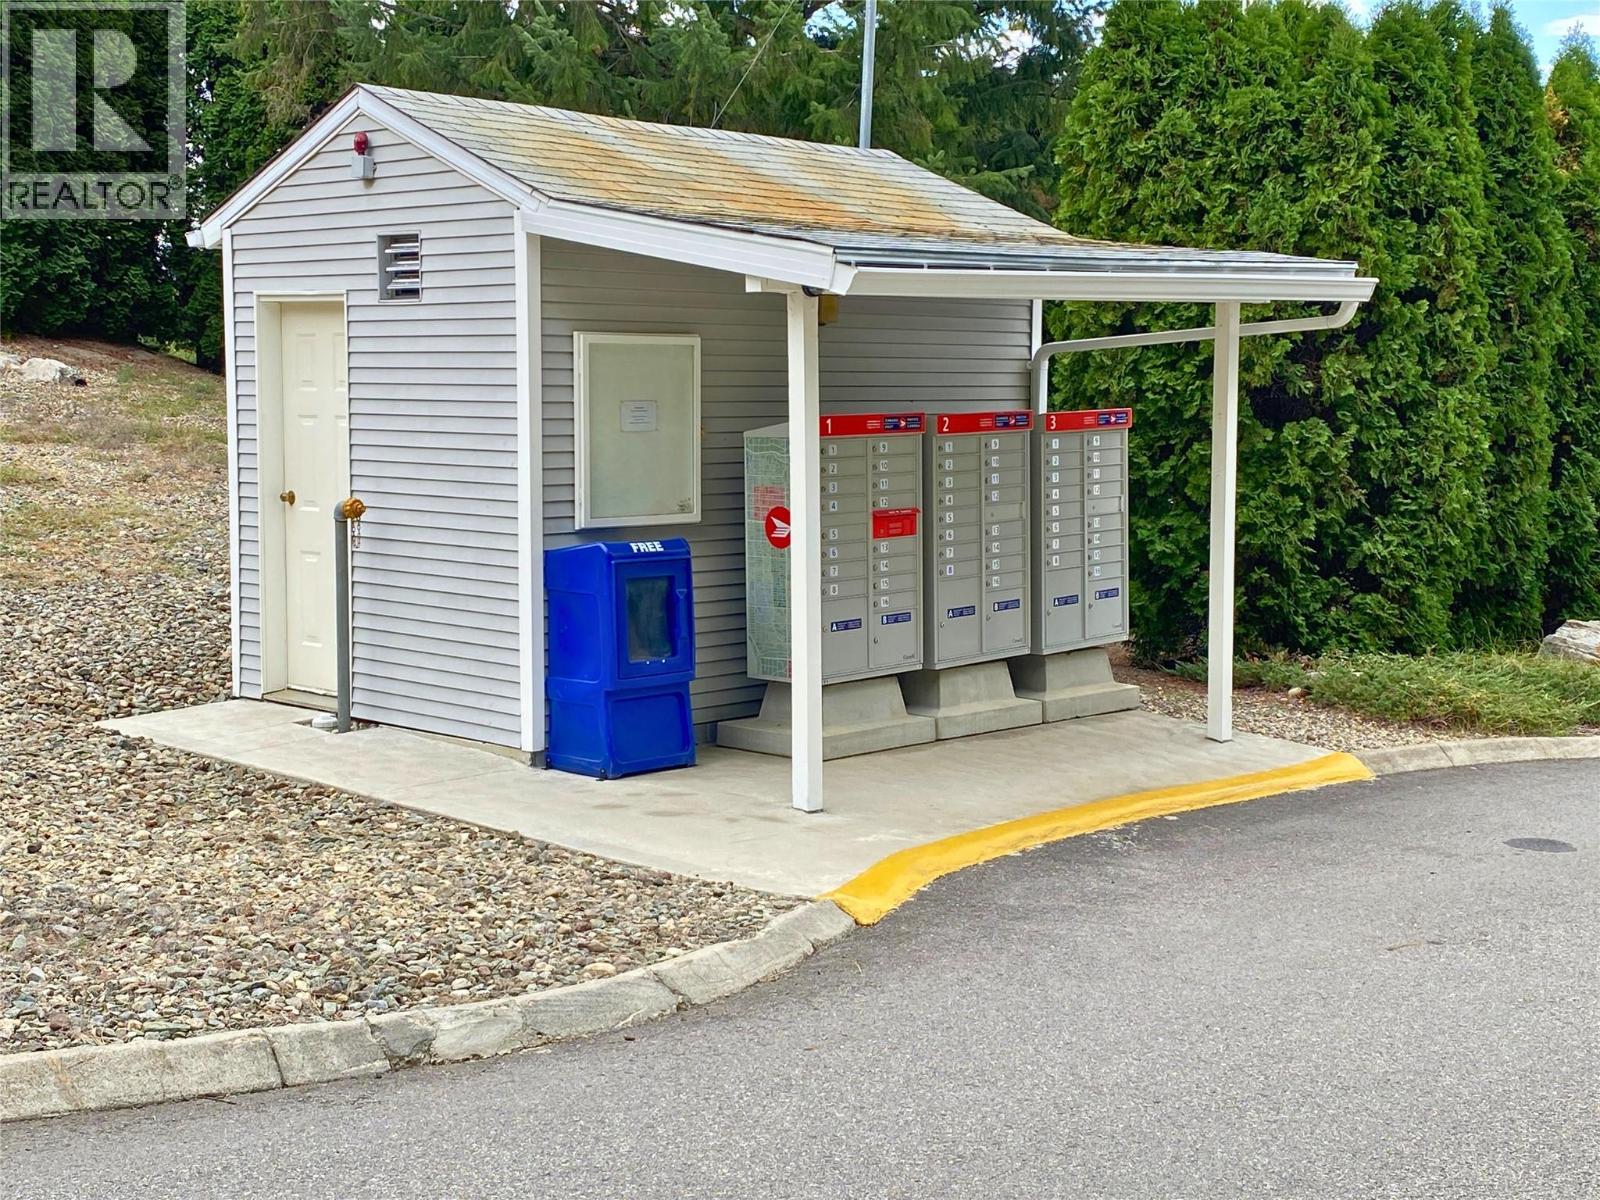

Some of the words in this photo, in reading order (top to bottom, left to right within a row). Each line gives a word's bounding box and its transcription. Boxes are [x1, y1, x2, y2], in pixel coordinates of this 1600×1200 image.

[826, 418, 832, 434] 1
[943, 417, 949, 432] 2
[1050, 415, 1056, 430] 3
[629, 541, 664, 553] FREE
[832, 623, 837, 631] A
